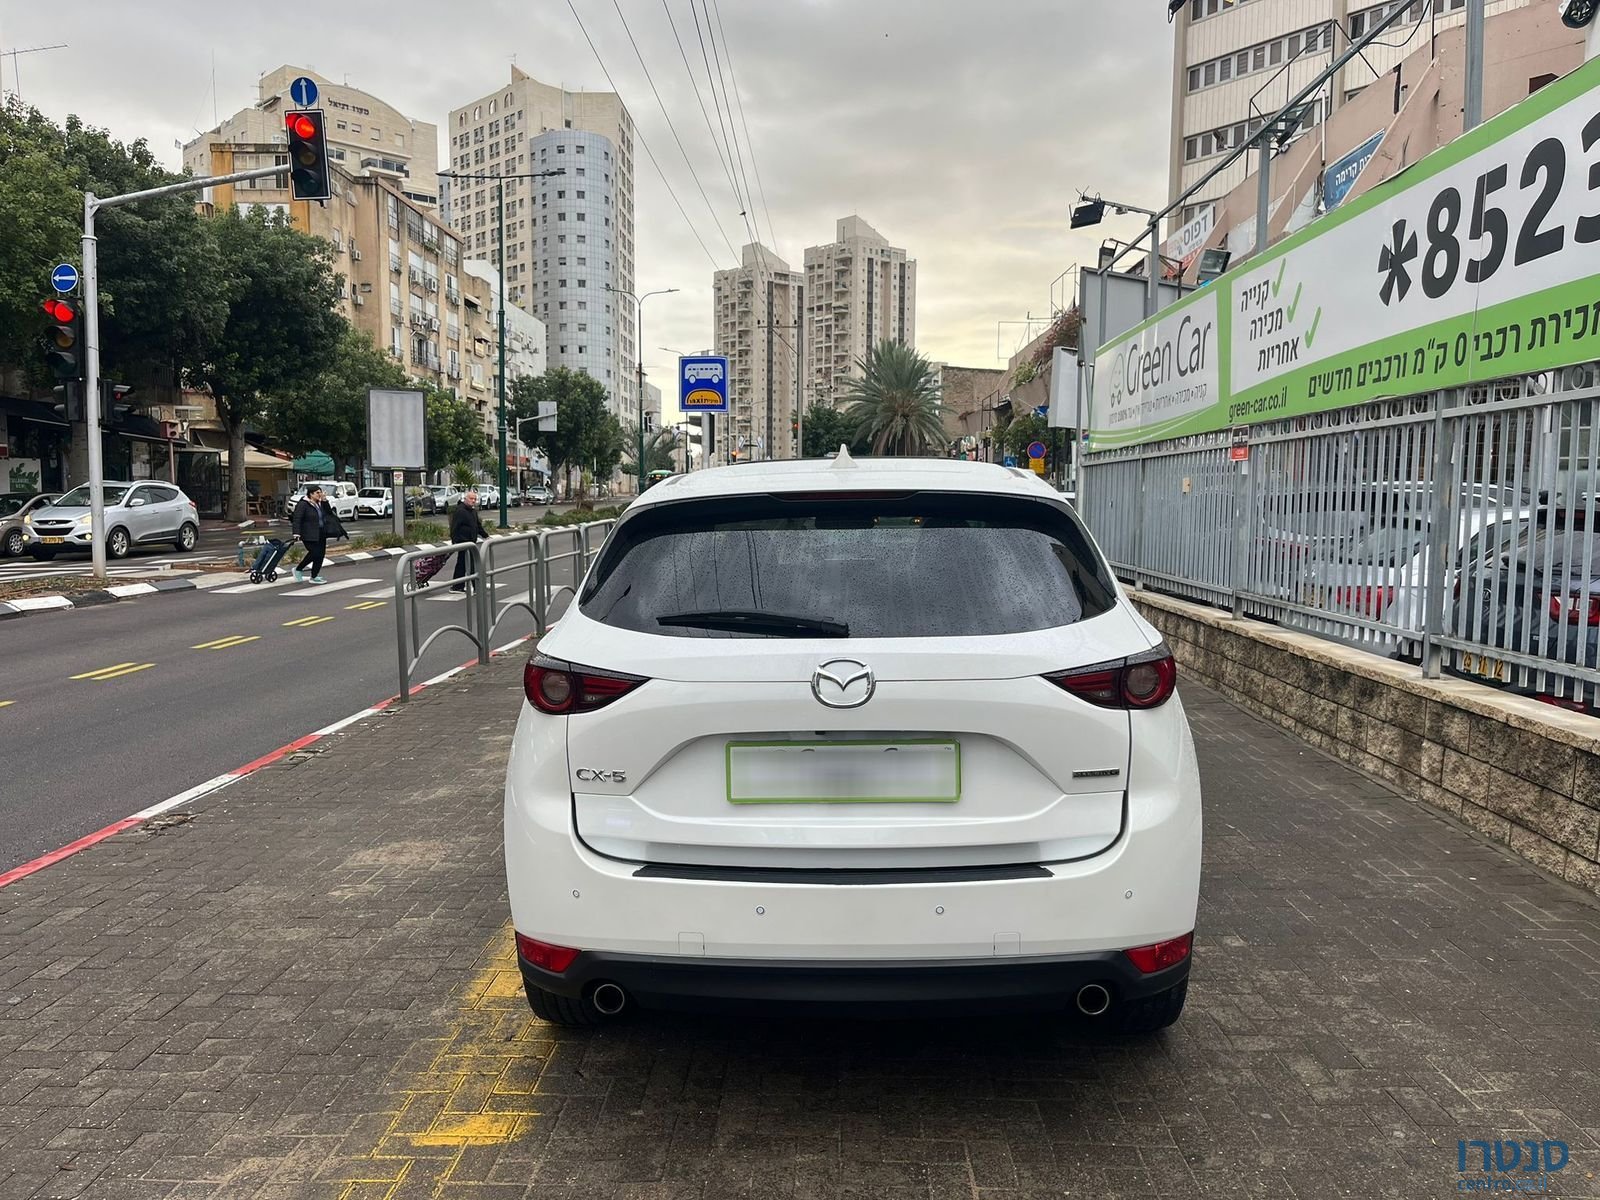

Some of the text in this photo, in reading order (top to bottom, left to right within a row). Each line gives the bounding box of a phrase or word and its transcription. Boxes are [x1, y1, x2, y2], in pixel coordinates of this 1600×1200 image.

[1335, 162, 1358, 186] קדימה
[1183, 214, 1208, 246] דפוס
[1241, 279, 1270, 312] קנייה
[1250, 307, 1283, 341] מכירה
[1126, 314, 1212, 396] Green Car
[1257, 336, 1300, 372] אחריות
[1454, 331, 1468, 367] 0
[1473, 323, 1521, 362] רכבי
[1308, 366, 1353, 398] חדשים
[1356, 351, 1408, 388] ורכבים
[1228, 386, 1288, 423] green-car.co.il
[575, 767, 627, 783] CX-5
